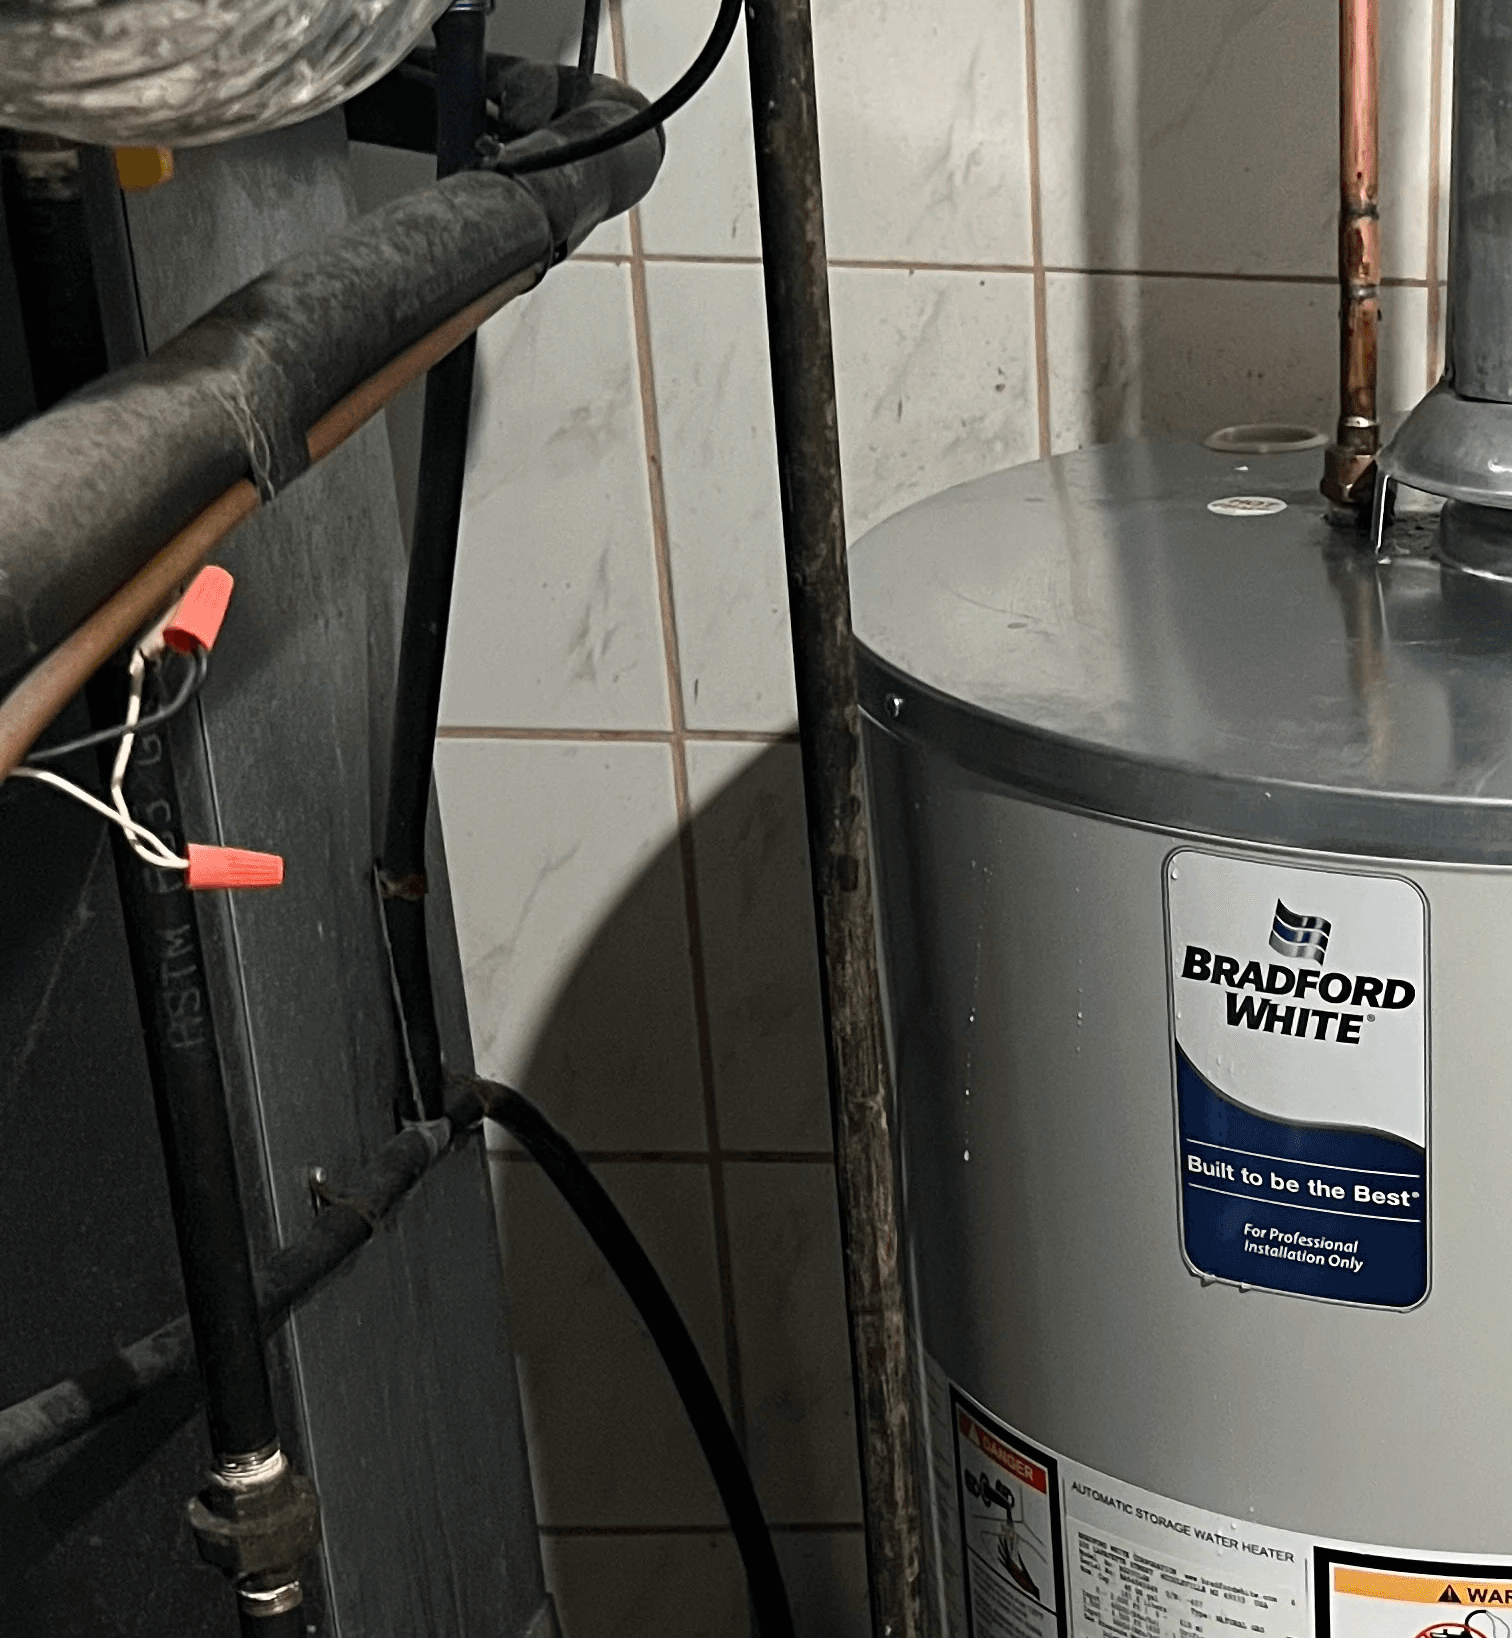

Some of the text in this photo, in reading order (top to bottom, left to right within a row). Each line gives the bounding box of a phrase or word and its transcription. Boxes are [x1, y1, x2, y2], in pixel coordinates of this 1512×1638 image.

[1181, 945, 1416, 1010] BRADFORD
[1187, 1154, 1235, 1182] Built
[1240, 1168, 1264, 1186] to
[1270, 1172, 1300, 1193] be
[1307, 1180, 1346, 1200] the
[1244, 1223, 1360, 1254] For Professional
[1244, 1239, 1364, 1274] Installation Only
[983, 1436, 1034, 1482] DANGER
[1071, 1481, 1294, 1564] AUTOMATIC STORAGE WATER HEATER
